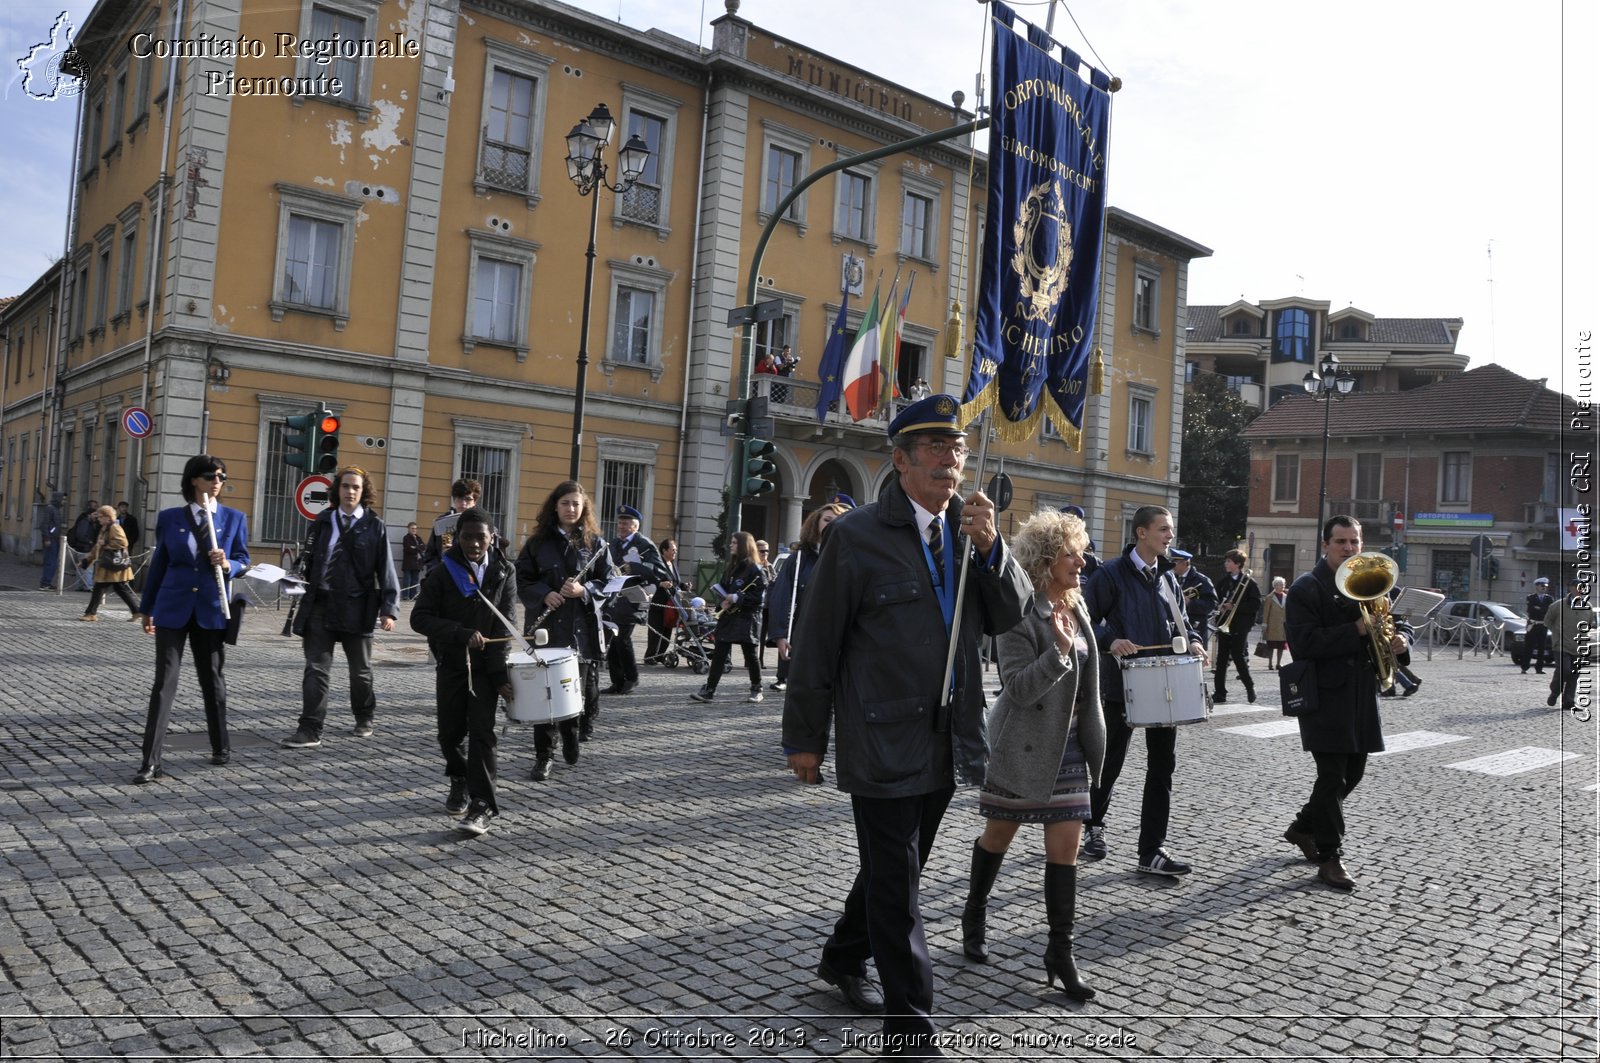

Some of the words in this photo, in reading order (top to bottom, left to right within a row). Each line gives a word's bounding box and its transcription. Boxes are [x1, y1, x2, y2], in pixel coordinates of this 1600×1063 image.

[787, 55, 912, 122] MUNICIPIO
[1003, 78, 1044, 111] ORPO
[1046, 80, 1104, 171] MUSICALE
[1001, 135, 1058, 172] GIACOMO
[1000, 315, 1084, 357] ICHELINO
[1058, 379, 1082, 395] 2007
